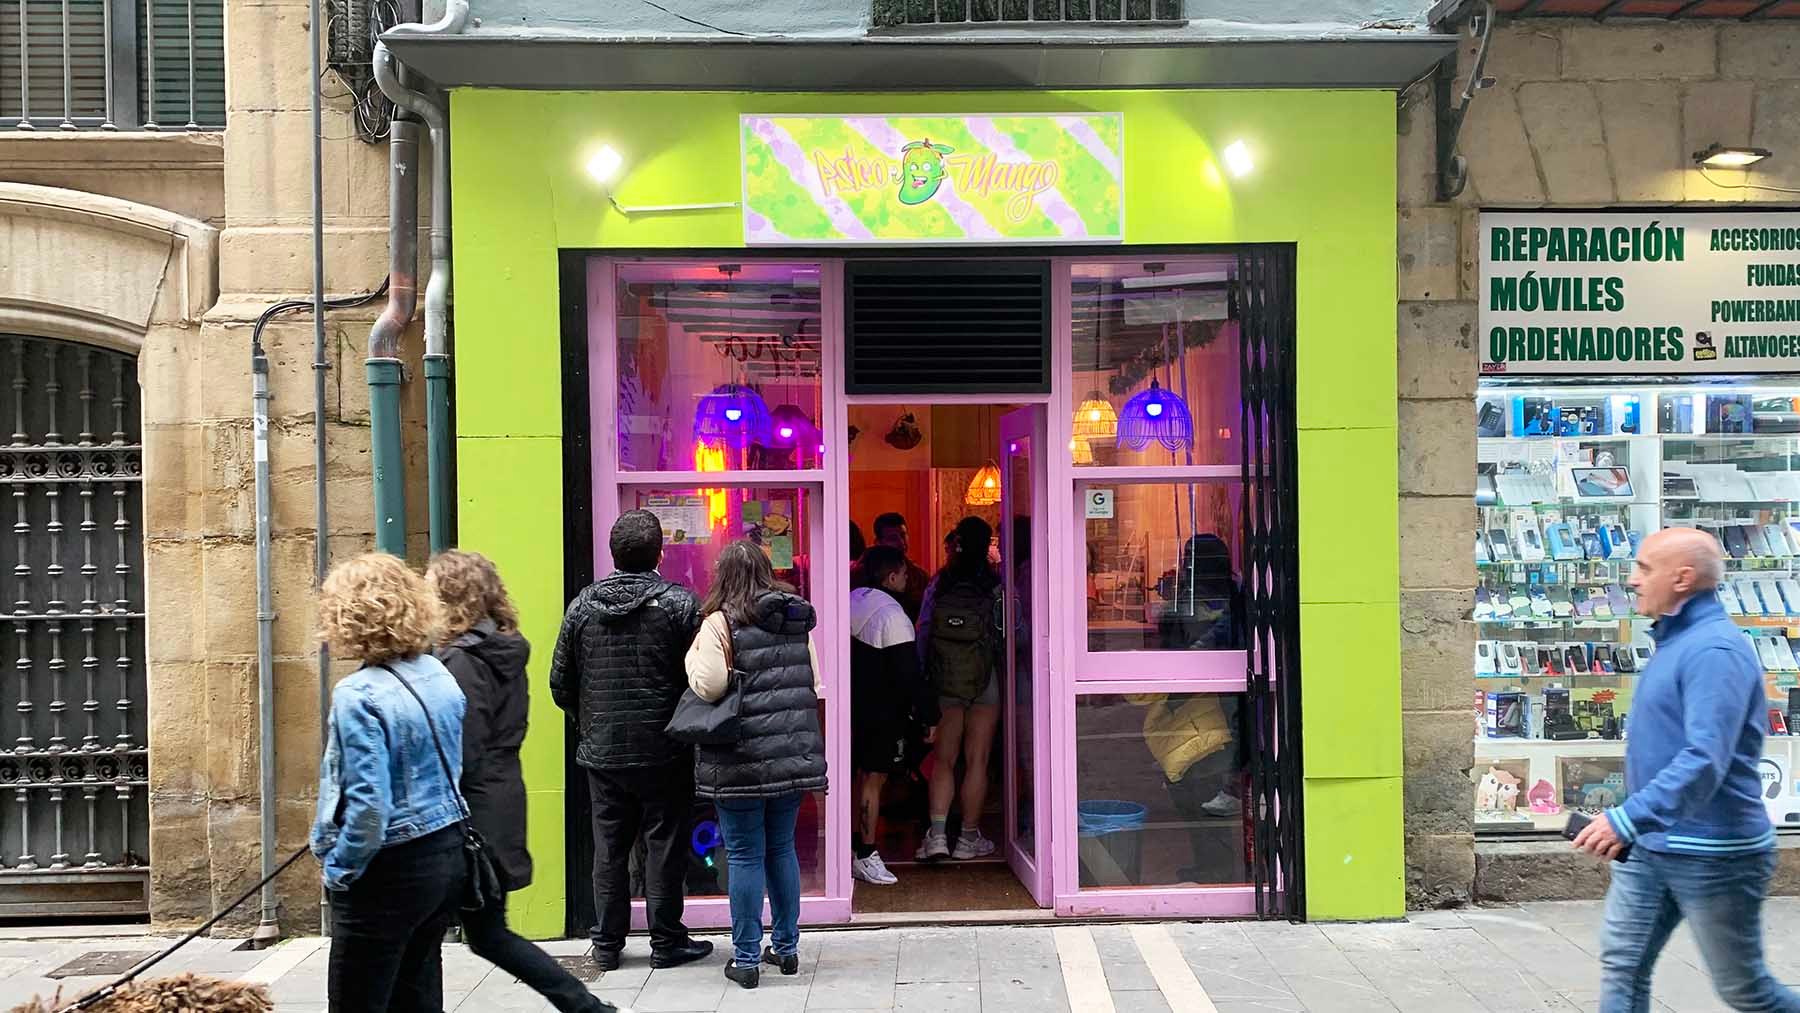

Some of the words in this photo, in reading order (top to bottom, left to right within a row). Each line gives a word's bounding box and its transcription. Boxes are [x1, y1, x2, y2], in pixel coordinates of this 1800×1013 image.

[947, 152, 1058, 222] Mango
[1490, 221, 1685, 262] REPARACIÓN
[1490, 271, 1625, 312] MÓVILES
[1489, 326, 1685, 362] ORDENADORES
[1093, 492, 1105, 505] G
